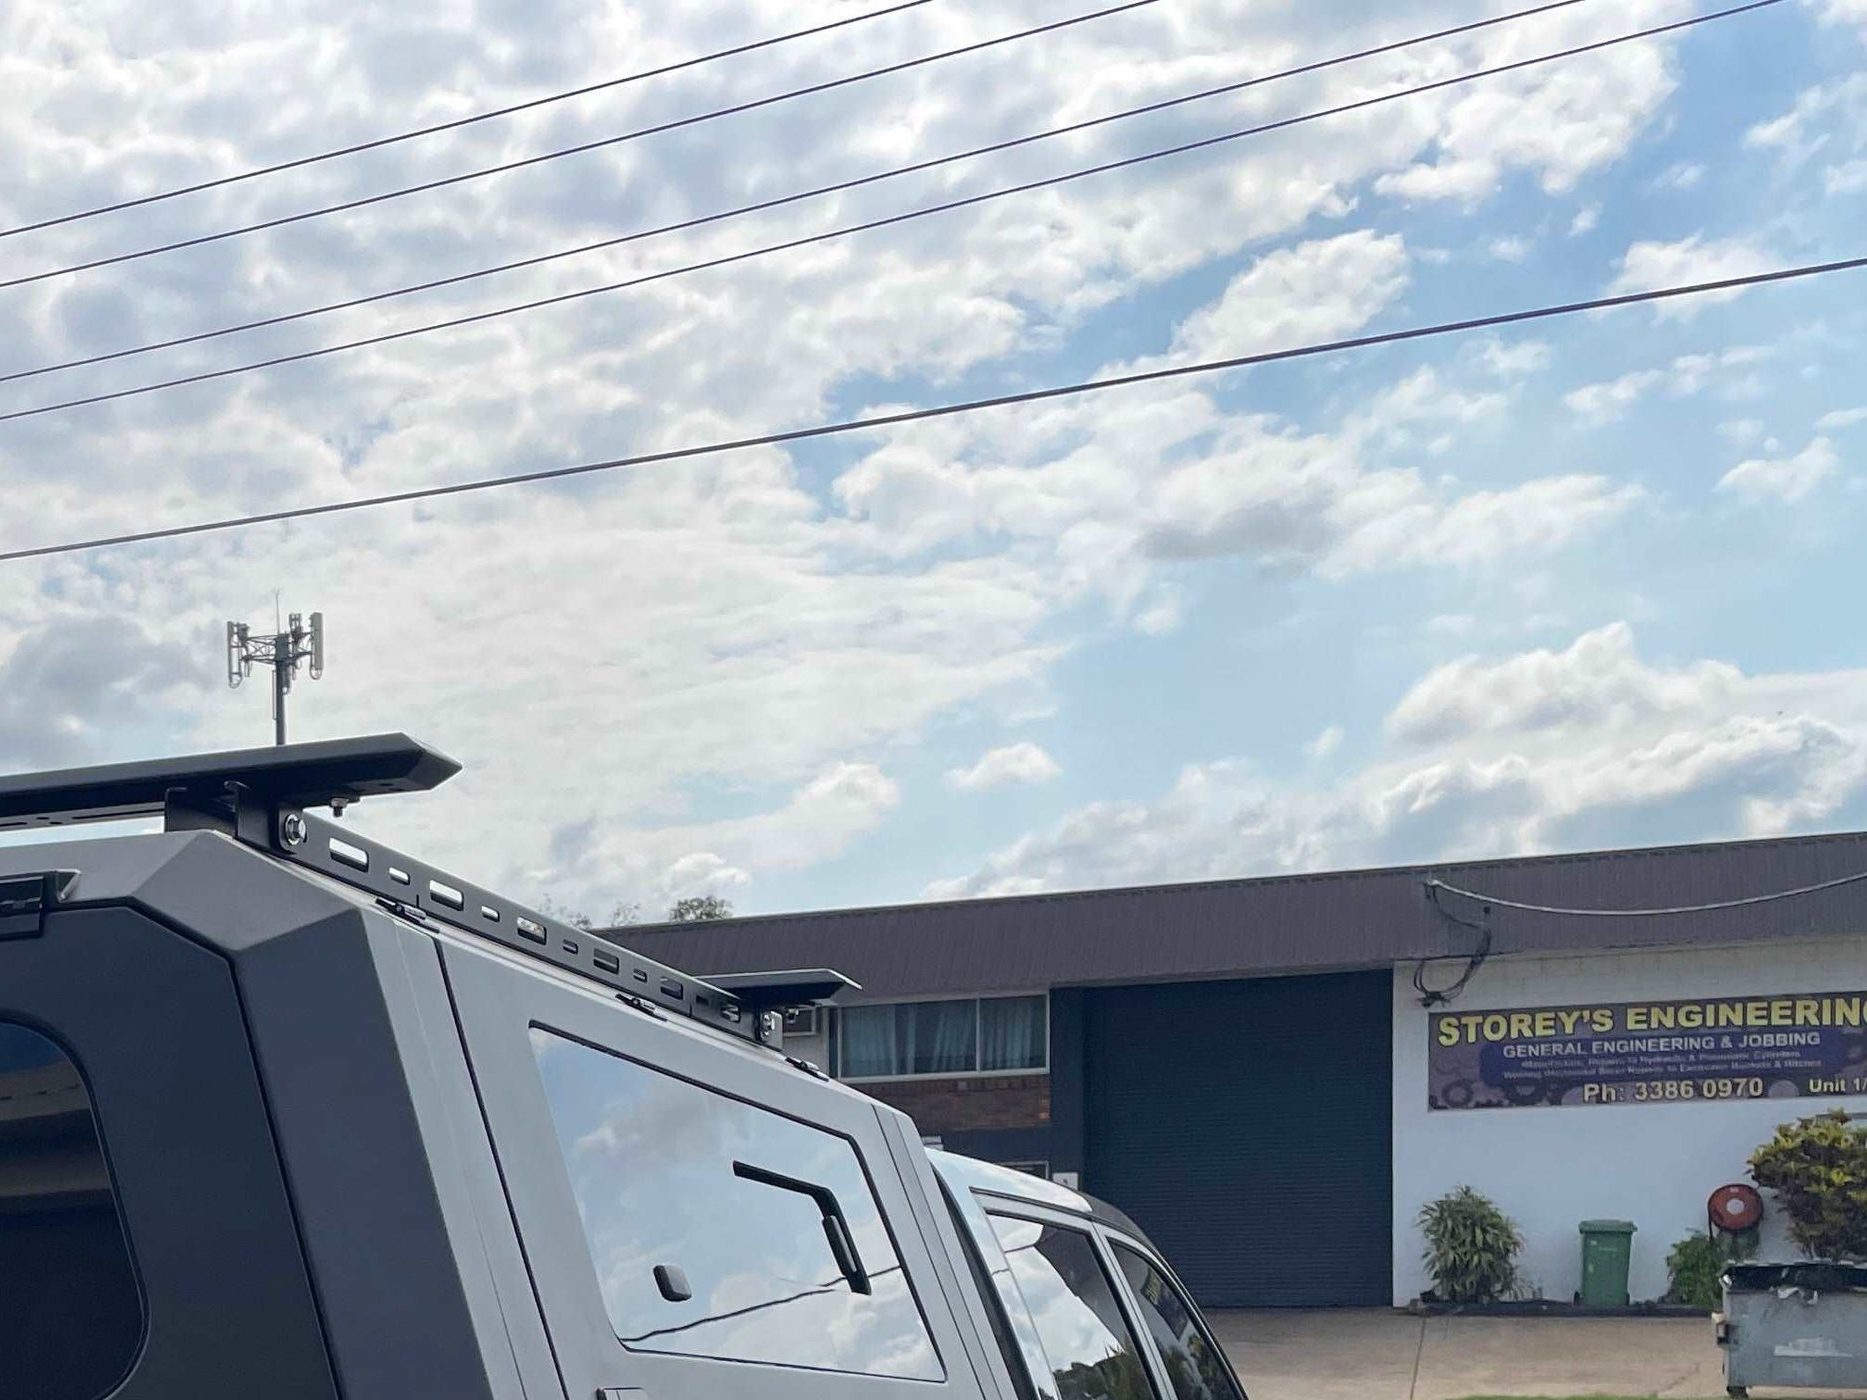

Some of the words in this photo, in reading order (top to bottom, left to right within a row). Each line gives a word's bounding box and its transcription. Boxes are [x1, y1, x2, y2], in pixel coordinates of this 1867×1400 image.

[1438, 1008, 1614, 1046] STOREY'S
[1626, 998, 1867, 1031] ENGINEERIN
[1503, 1042, 1586, 1059] GENERAL
[1591, 1035, 1715, 1054] ENGINEERING
[1720, 1035, 1733, 1049] &
[1738, 1031, 1821, 1048] JOBBING
[1584, 1083, 1624, 1101] Ph:
[1635, 1080, 1694, 1100] 3386
[1702, 1077, 1764, 1098] 0970
[1808, 1078, 1846, 1093] Unit
